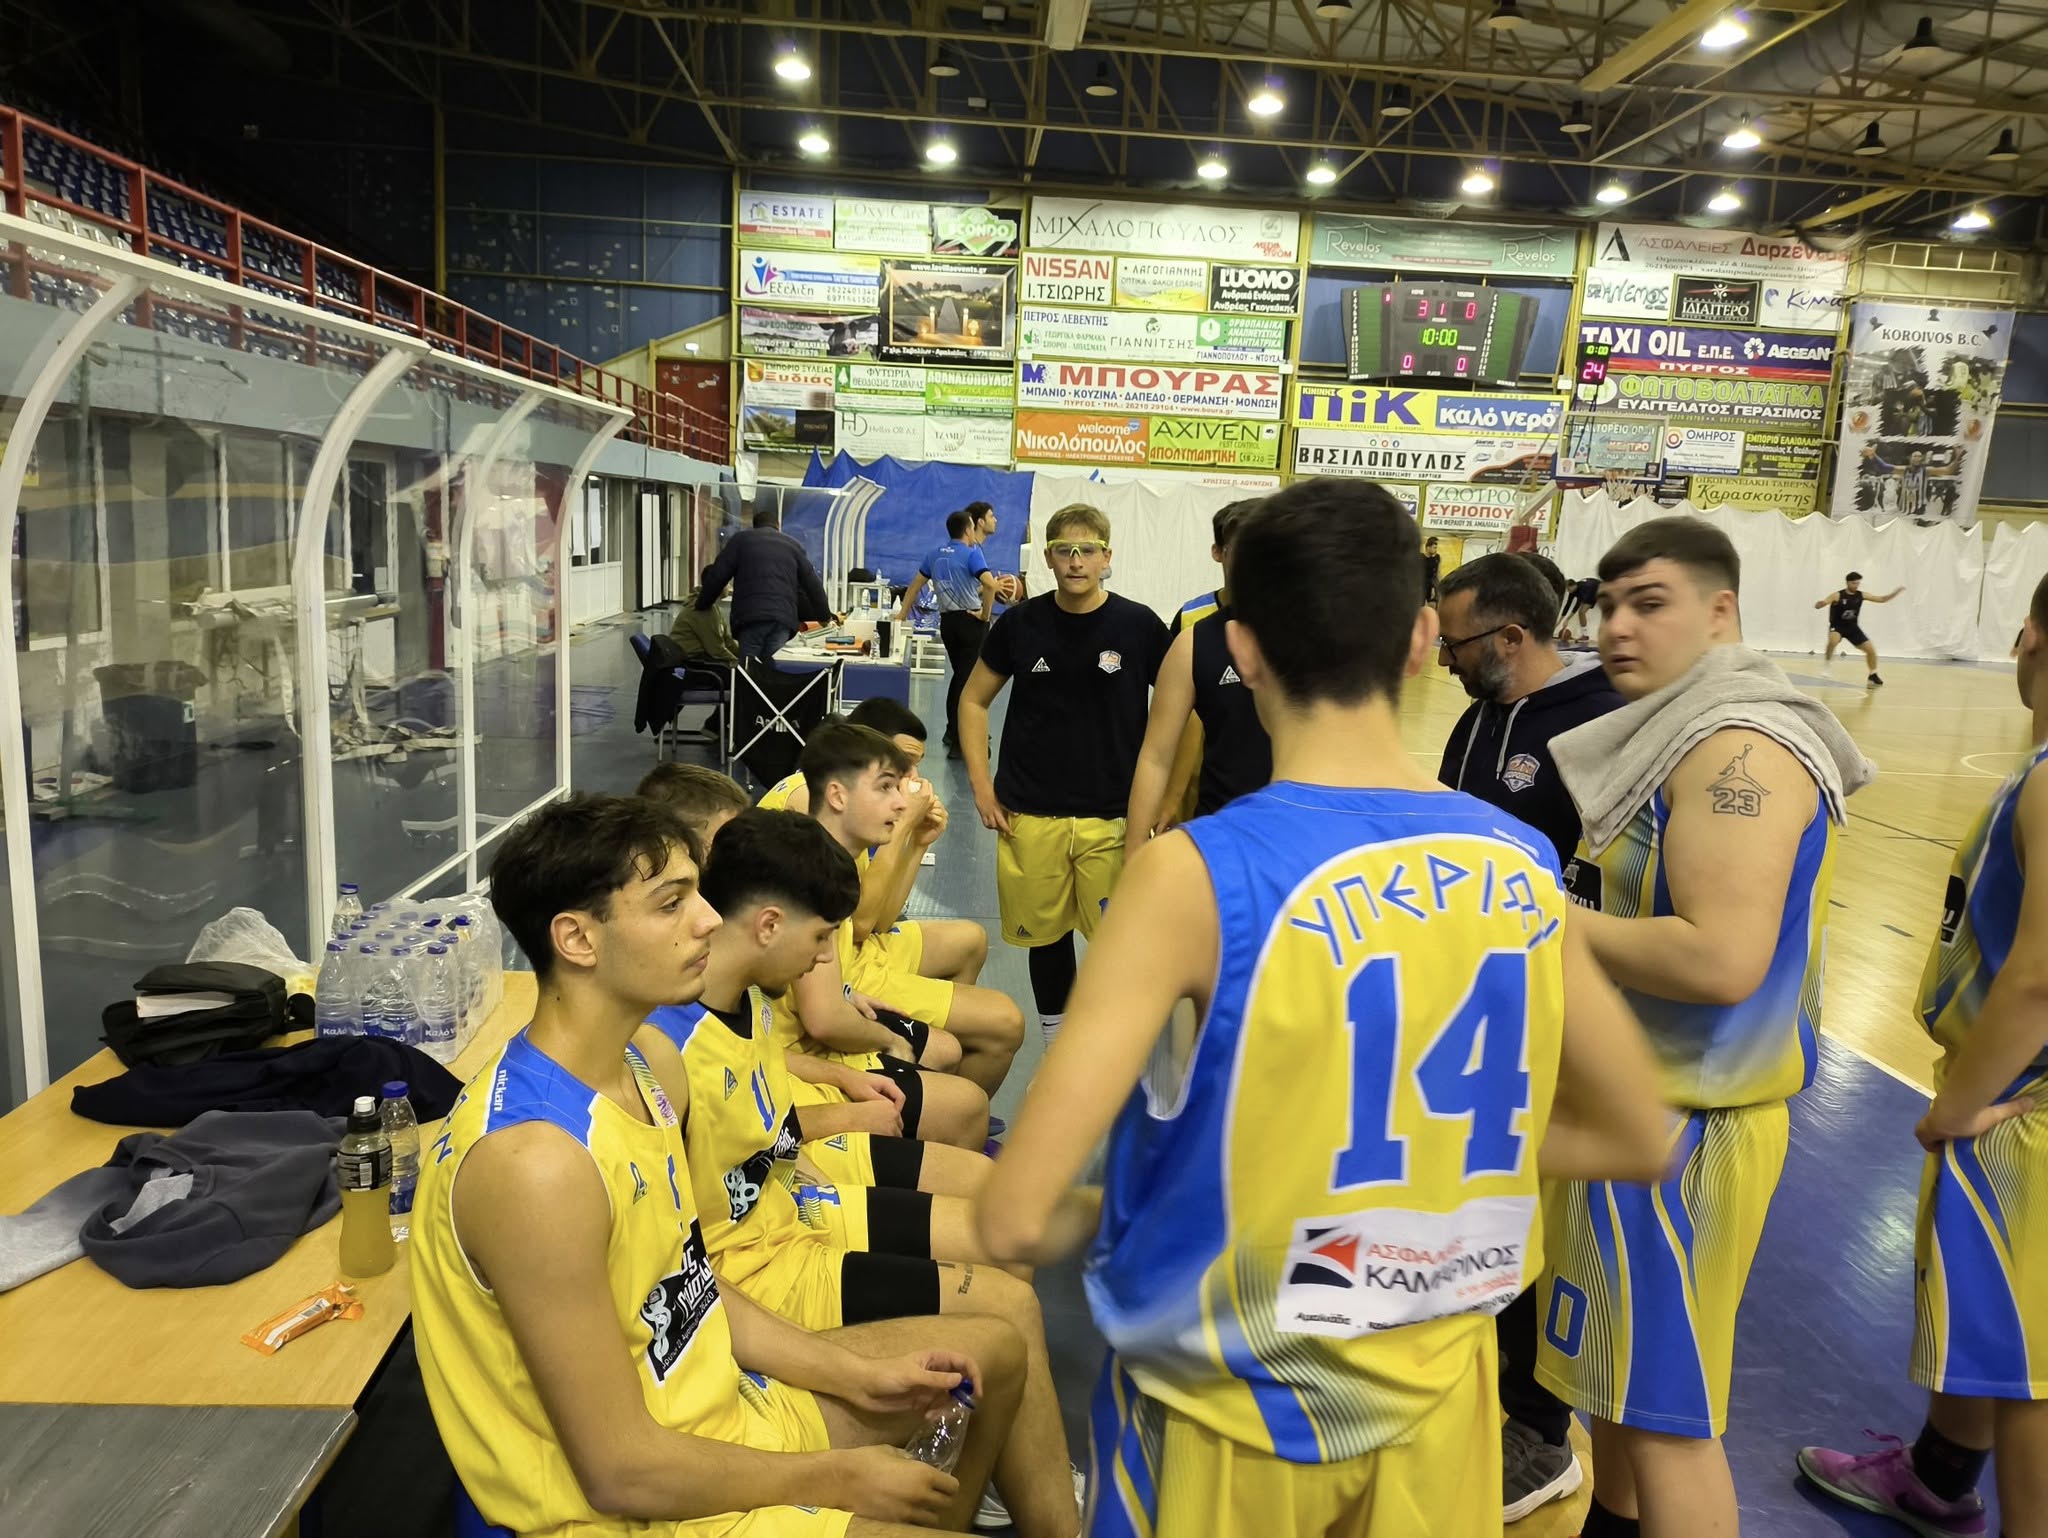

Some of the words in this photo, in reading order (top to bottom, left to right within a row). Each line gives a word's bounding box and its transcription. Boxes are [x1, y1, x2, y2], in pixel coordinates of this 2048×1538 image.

[772, 205, 825, 219] ESTATE
[1035, 203, 1243, 248] ΜΙΧΑΛΟΠΟΥΛΟΣ
[1638, 236, 1733, 254] ΑΣΦΑΛΕΙΕΣ
[1026, 256, 1110, 280] NISSAN
[1219, 268, 1294, 290] L'UOMO
[1417, 300, 1429, 317] 3
[1465, 302, 1476, 319] 0
[1023, 310, 1060, 323] ΠΕΤΡΟΣ
[1061, 314, 1109, 327] ΛΕΒΕΝΤΗΣ
[1110, 336, 1195, 350] ΓΙΑΝΝΙΤΣΗΣ
[1581, 326, 1641, 355] TAXI
[1648, 329, 1691, 358] OIL
[1882, 327, 1953, 345] KOROIVOS
[1402, 354, 1413, 370] 0
[1767, 344, 1831, 361] AEGEAN
[766, 362, 800, 372] ΕΜΠΟΡΙΟ
[866, 367, 911, 378] ΦΥΤΩΡΙΑ
[1456, 357, 1467, 372] 0
[1582, 361, 1605, 380] 24
[1659, 362, 1749, 375] ΠΥΡΓΟΣ
[765, 370, 833, 387] Ξυδιάς
[1059, 365, 1280, 396] ΜΠΟΥΡΑΣ
[1025, 387, 1067, 399] ΜΠΑΝΙΟ
[1073, 389, 1118, 401] ΚΟΥΖΙΝΑ
[1124, 392, 1166, 403] ΔΑΠΕΔΟ
[1172, 394, 1229, 406] ΘΕΡΜΑΝΣΗ
[1235, 397, 1278, 409] ΜΟΝΩΣΗ
[1619, 374, 1825, 409] ΦΩΤΟΒΟΛΤΑΪΚΑ
[1617, 398, 1731, 416] ΕΥΑΓΓΕΛΑΤΟΣ
[1733, 406, 1822, 422] ΓΕΡΑΣΙΜΟΣ
[1077, 421, 1131, 435] welcome
[1153, 420, 1261, 442] AXIVEN
[1686, 429, 1736, 443] ΟΜΗΡΟΣ
[1016, 429, 1146, 459] Νικολόπουλος
[1150, 446, 1237, 463] ΑΠΟΛΥΜΑΝΤΙΚΗ
[1298, 447, 1466, 472] ΒΑΣΙΛΟΠΟΥΛΟΣ
[1698, 484, 1812, 507] Καρασκούτης
[1428, 503, 1547, 522] ΣΥΡΙΟΠΟΥΣ
[1712, 787, 1761, 818] 23
[1329, 951, 1531, 1195] 14
[493, 1068, 508, 1113] nickan
[1544, 1274, 1590, 1360] 0
